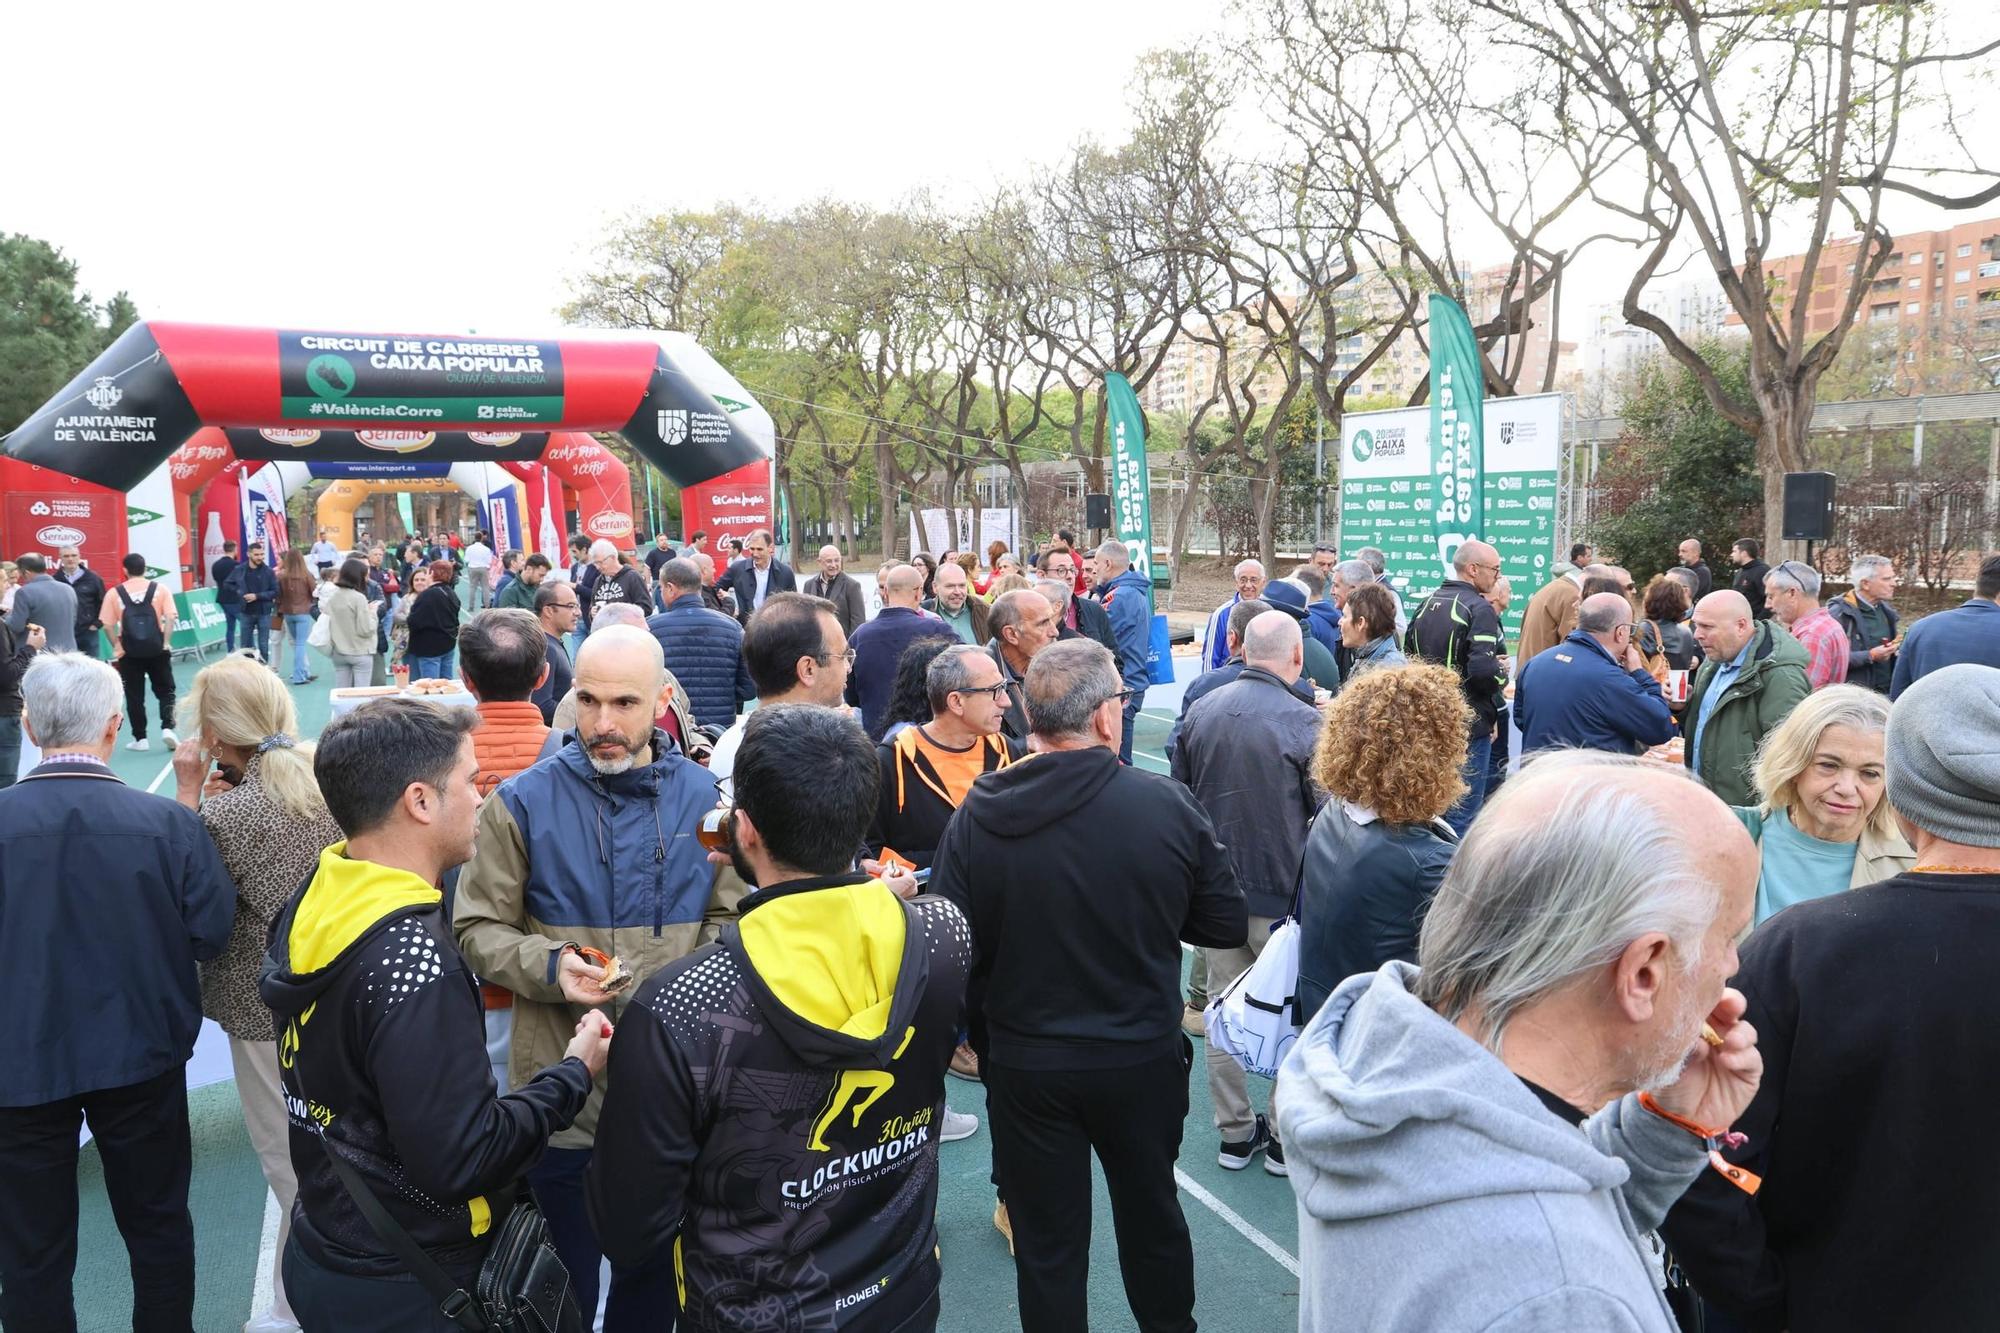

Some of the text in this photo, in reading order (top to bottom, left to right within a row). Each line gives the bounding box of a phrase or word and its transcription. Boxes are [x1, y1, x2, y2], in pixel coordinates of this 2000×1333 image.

[300, 336, 540, 357] CIRCUIT DE CARRERES
[446, 373, 481, 384] CIUTAT
[483, 374, 496, 384] DE
[309, 402, 443, 417] #ValènciaCorre
[55, 415, 156, 428] AJUNTAMENT
[54, 428, 156, 442] DE VALÈNCIA
[1375, 439, 1405, 449] CAIXA
[348, 464, 416, 472] www.intersport.es
[52, 504, 90, 512] TRINIDAD
[594, 519, 631, 530] Serrano
[722, 515, 766, 526] INTERSPORT
[43, 531, 80, 542] Serrano
[781, 1126, 928, 1198] CLOCKWORK
[784, 1183, 840, 1210] PREPARACIÓN
[843, 1174, 872, 1188] FÍSICA
[873, 1171, 880, 1180] Y
[835, 1284, 880, 1311] FLOWER
